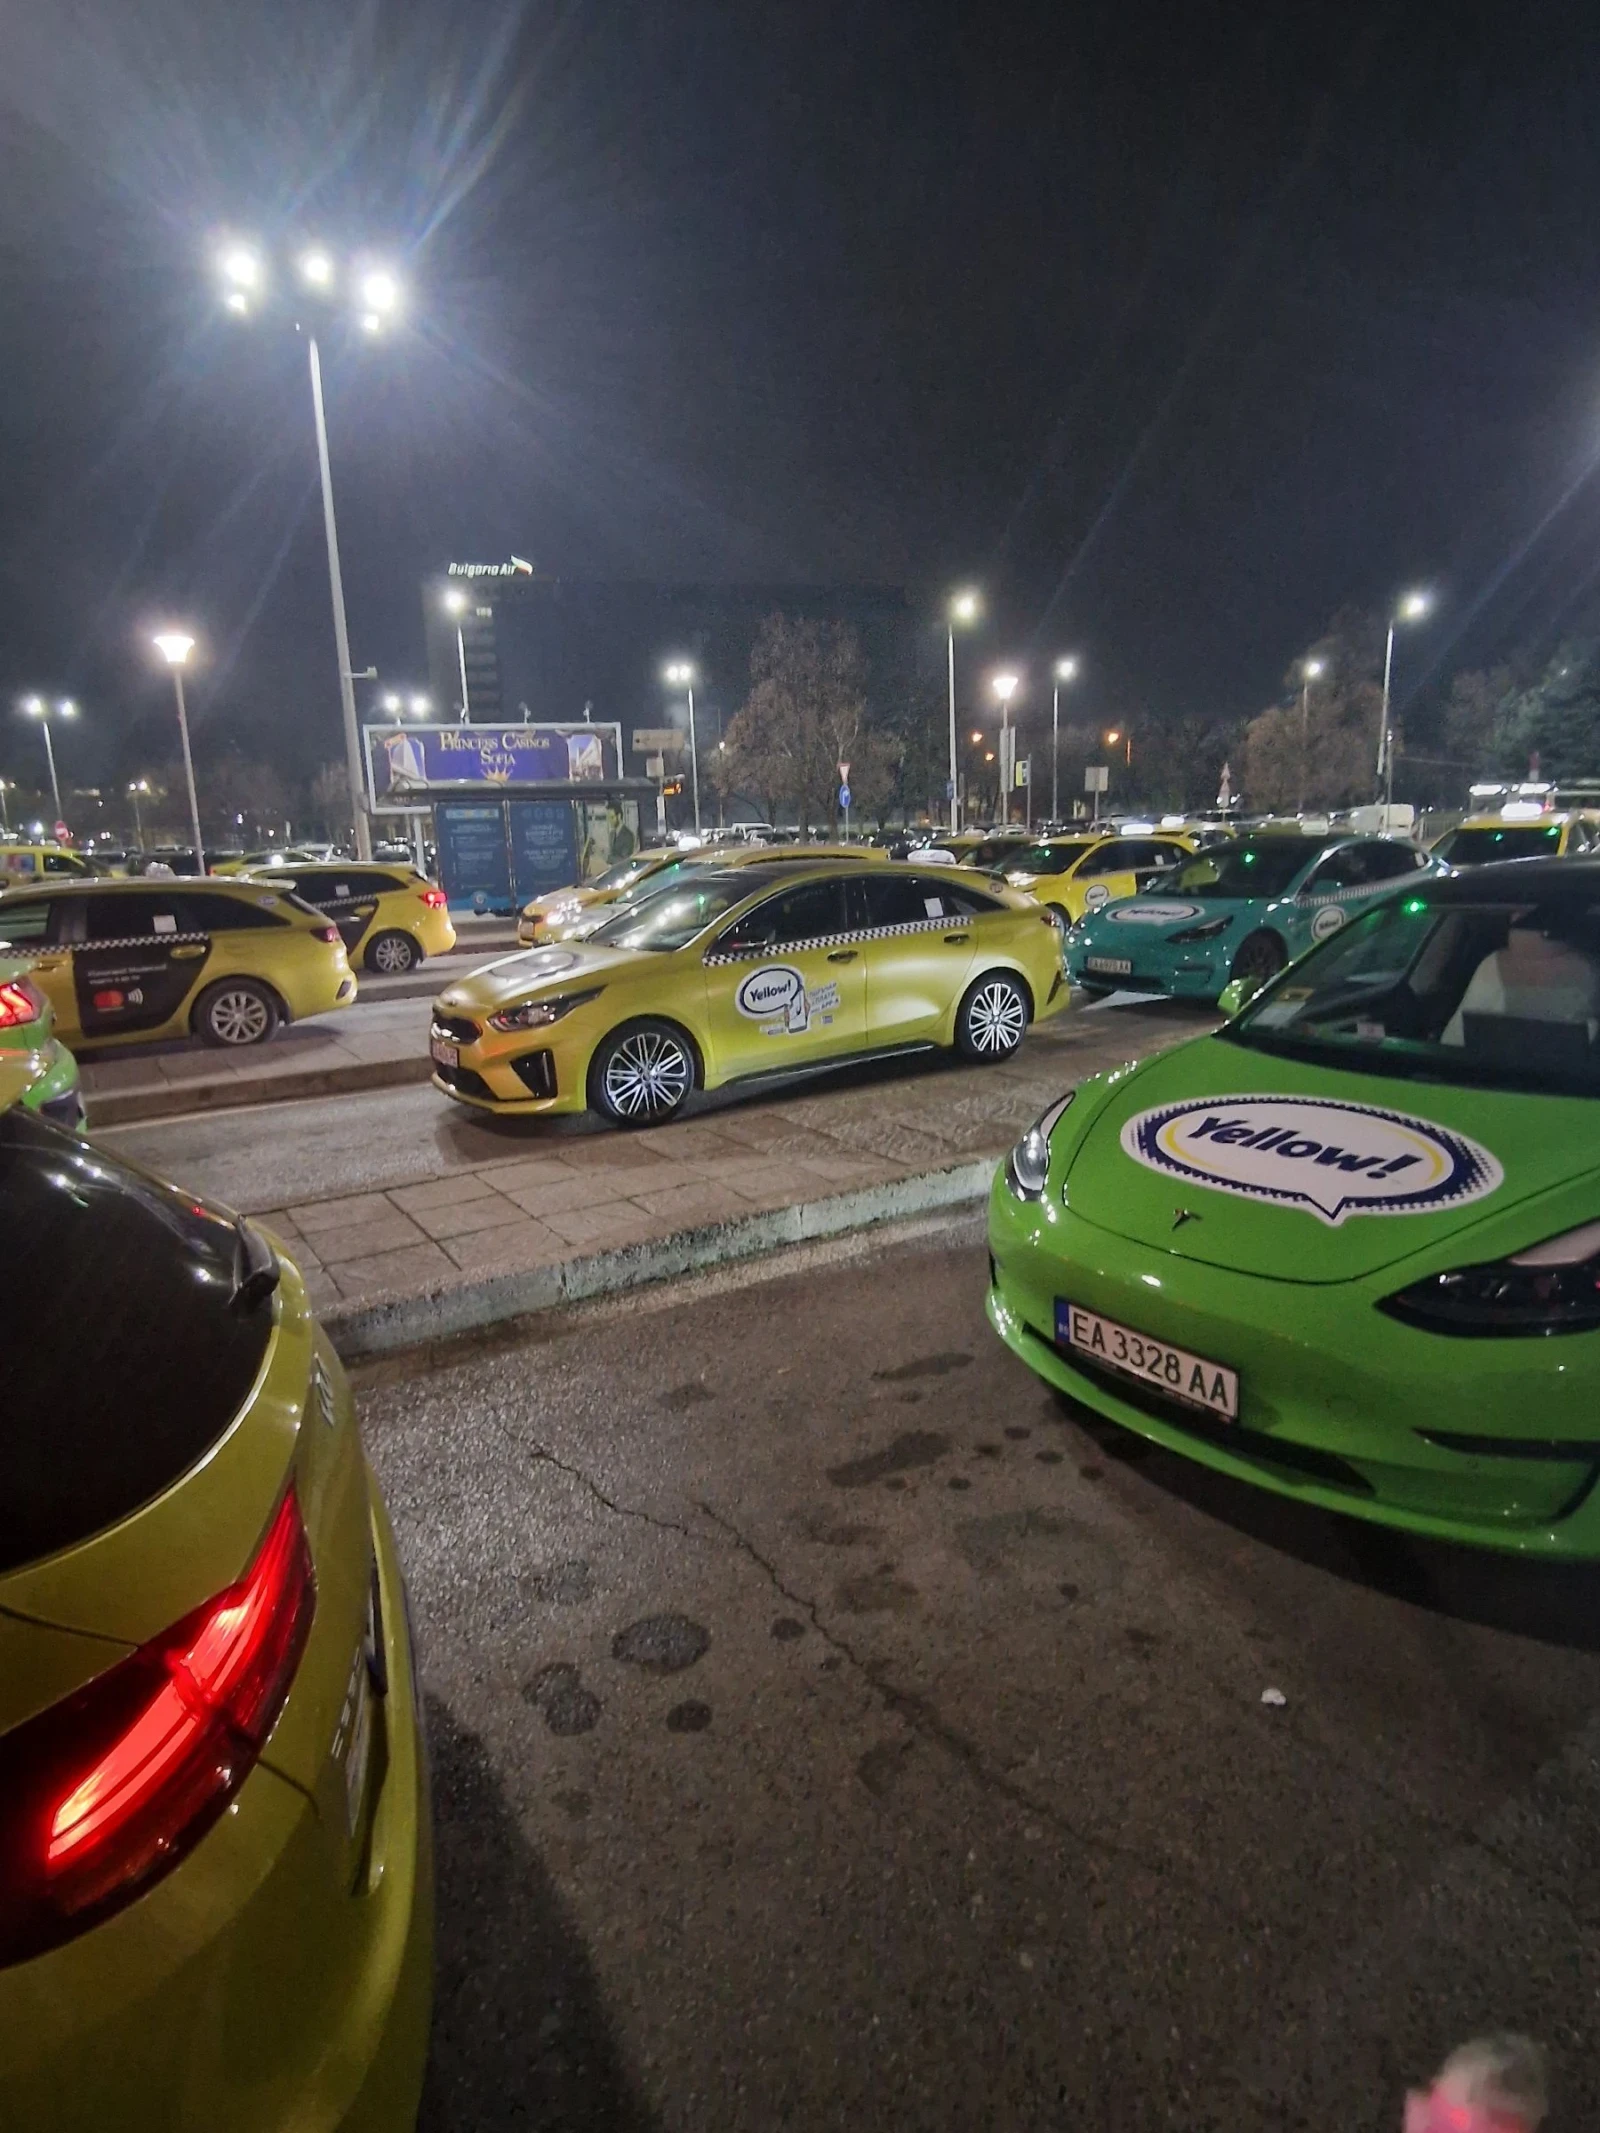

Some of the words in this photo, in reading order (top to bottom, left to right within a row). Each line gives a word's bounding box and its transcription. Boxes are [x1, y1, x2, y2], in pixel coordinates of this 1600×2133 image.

[448, 562, 499, 579] Bulgaria
[500, 563, 517, 576] Air
[750, 979, 791, 1002] Yellow!
[1187, 1116, 1423, 1179] Yellow!
[1073, 1312, 1106, 1353] EA
[1112, 1330, 1181, 1384] 3328
[1188, 1363, 1228, 1407] AA
